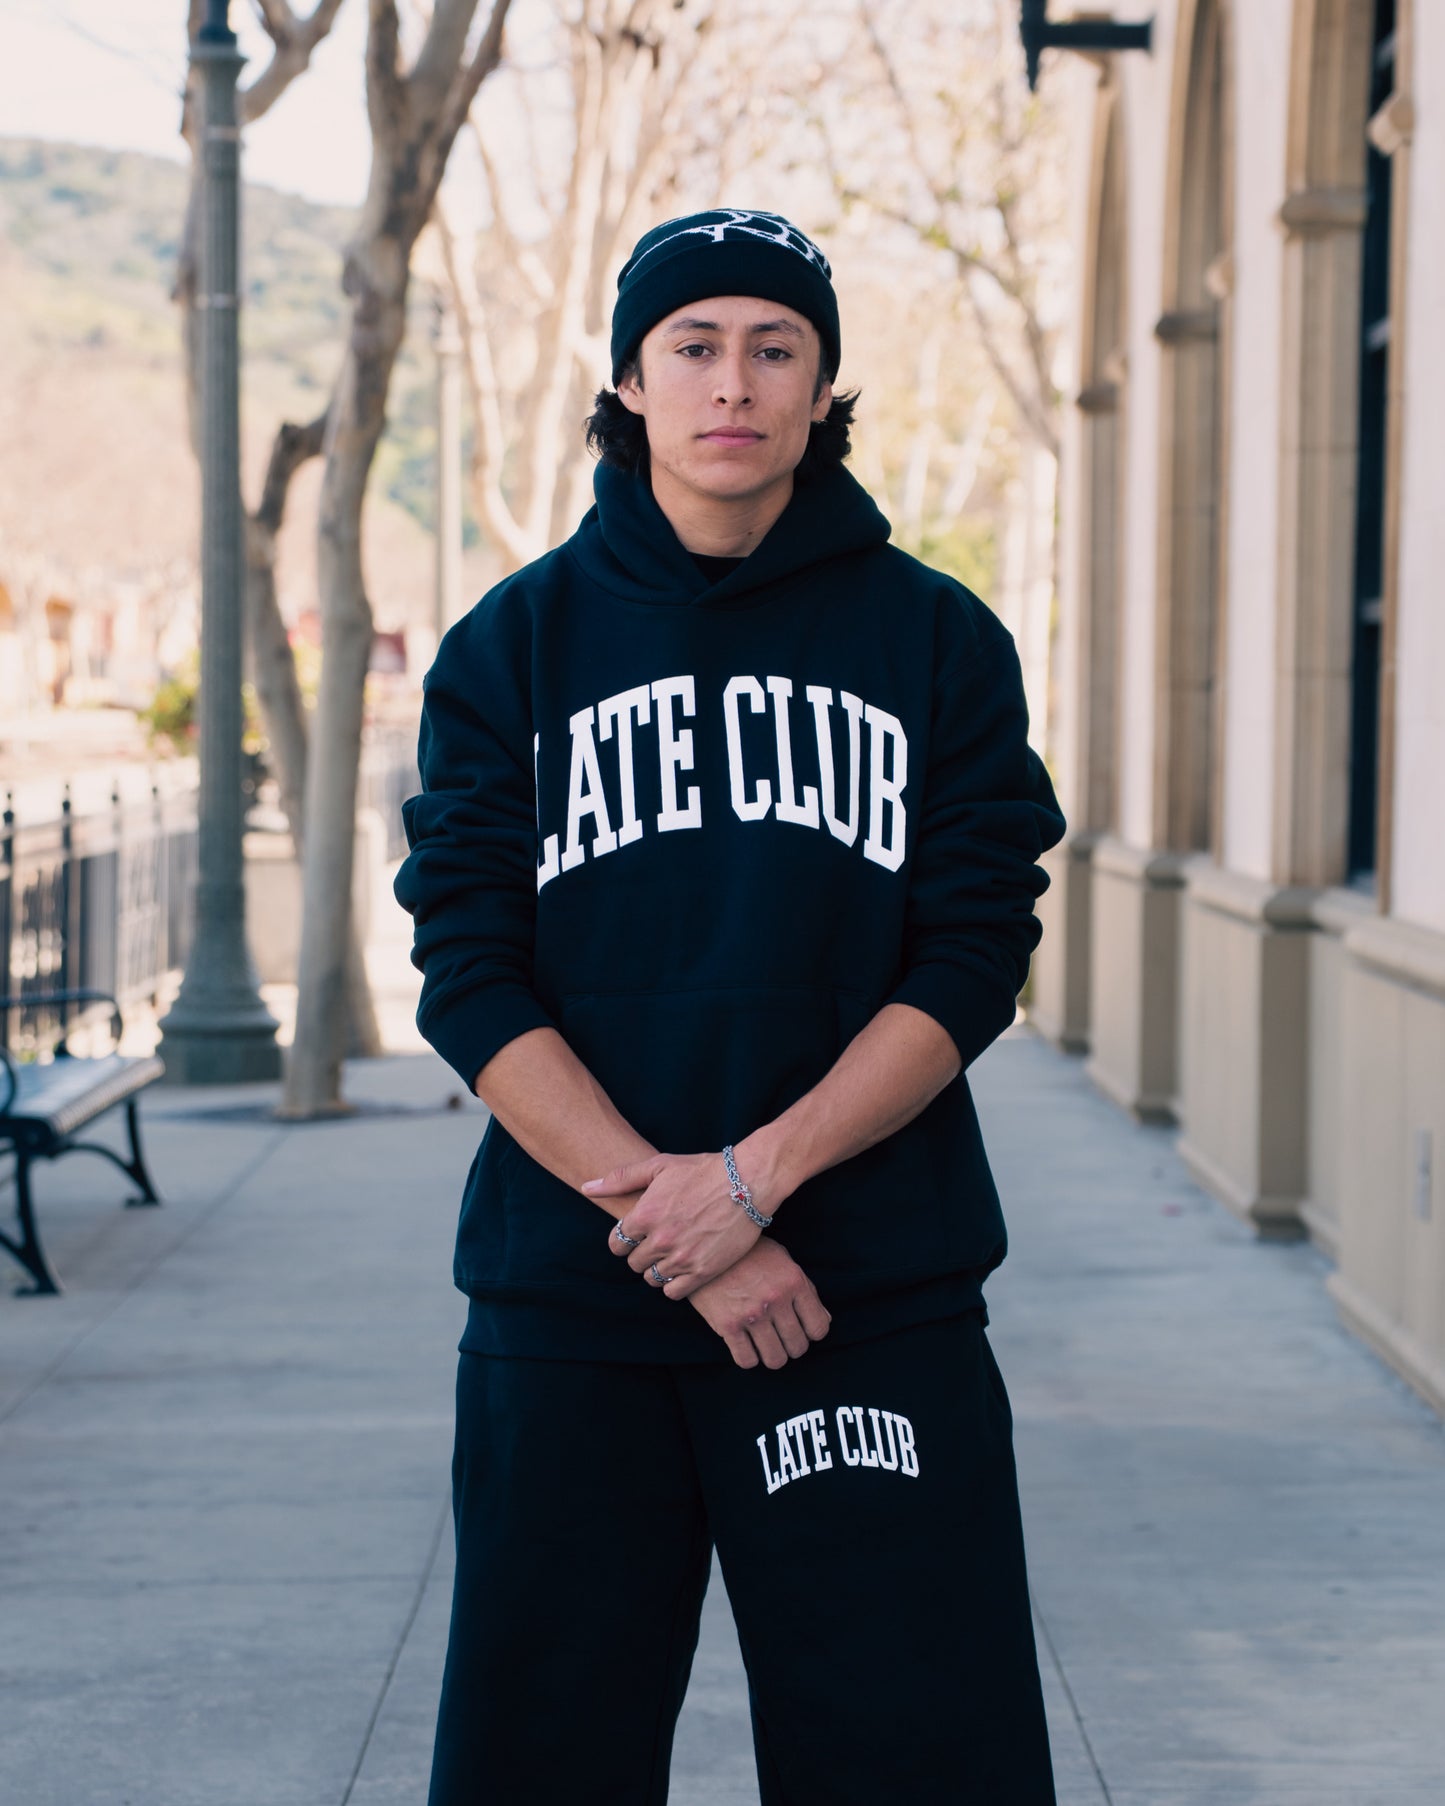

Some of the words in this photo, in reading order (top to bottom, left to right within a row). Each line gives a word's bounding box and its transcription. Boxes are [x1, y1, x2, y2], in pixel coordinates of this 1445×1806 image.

[534, 675, 702, 895] ATE
[722, 675, 908, 873] CLUB
[756, 1409, 833, 1495] LATE
[835, 1406, 920, 1478] CLUB
